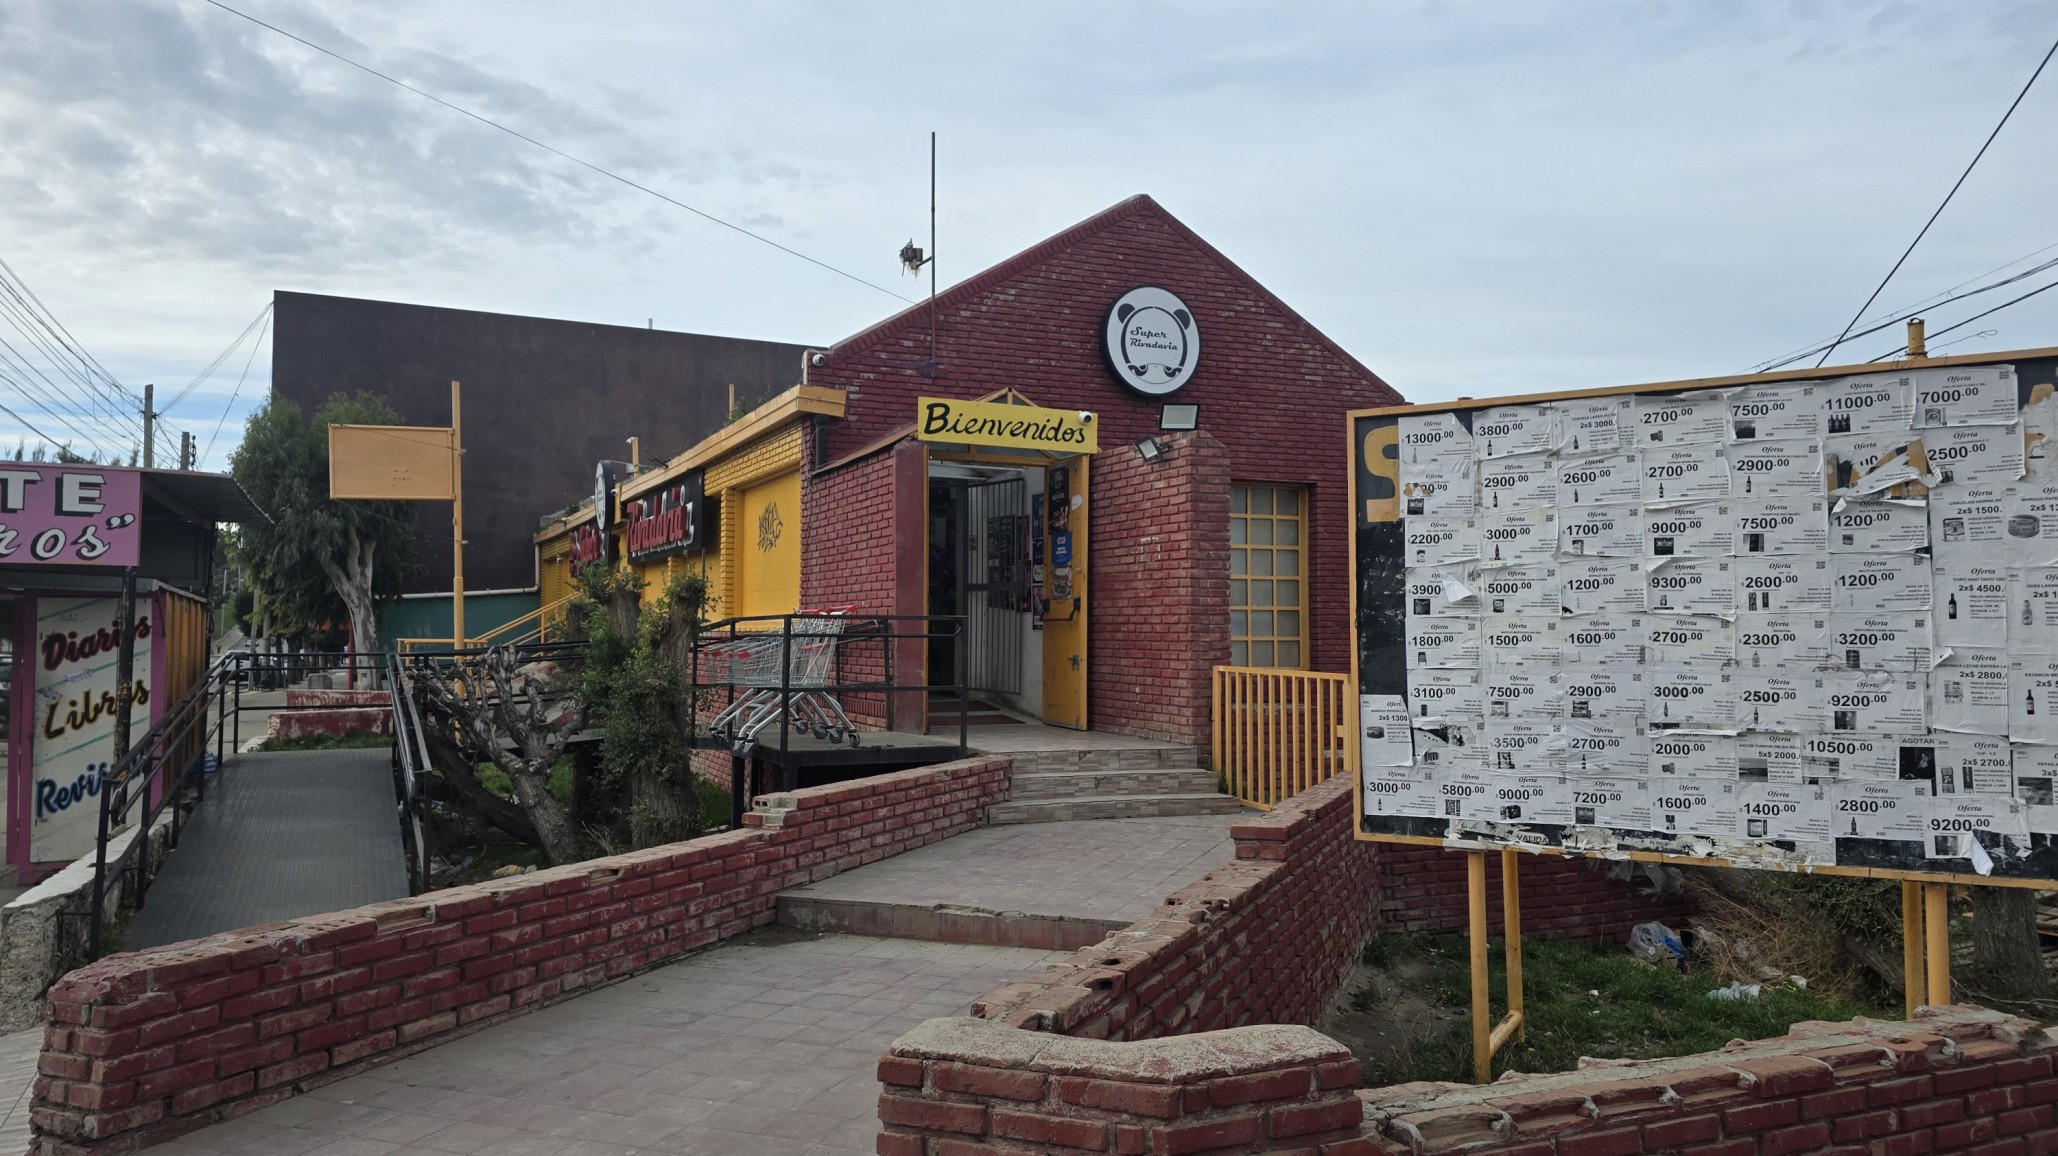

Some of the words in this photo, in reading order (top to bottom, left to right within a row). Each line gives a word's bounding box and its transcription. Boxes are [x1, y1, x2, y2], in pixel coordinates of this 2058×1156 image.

[1130, 326, 1167, 339] Super
[1947, 375, 1972, 383] Oferta
[1850, 382, 1873, 390] Oferta
[1499, 411, 1519, 420] Oferta
[924, 402, 1085, 443] Bienvenidos
[1423, 420, 1442, 428] Oferta
[1953, 431, 1978, 439] Oferta
[1853, 442, 1877, 450] Oferta
[1584, 458, 1605, 466] Oferta
[1504, 463, 1524, 471] Oferta
[1425, 472, 1444, 480] Oferta
[1859, 500, 1883, 508] Oferta
[2030, 504, 2046, 512] 2x$
[1957, 507, 1972, 515] 2x$
[1971, 567, 1996, 575] Oferta
[1676, 619, 1697, 627] Oferta
[1767, 620, 1790, 628] Oferta
[1864, 619, 1889, 627] Oferta
[41, 616, 152, 671] Diaris
[1971, 654, 1997, 662] Oferta
[1590, 673, 1611, 681] Oferta
[1676, 673, 1698, 681] Oferta
[1959, 671, 1975, 679] 2x$
[1767, 678, 1790, 686] Oferta
[2036, 680, 2052, 688] 2x$
[43, 678, 150, 740] Librs
[1513, 725, 1533, 733] Oferta
[1593, 726, 1614, 734] Oferta
[1769, 735, 1792, 743] Oferta
[1974, 741, 1999, 749] Oferta
[1461, 773, 1480, 781] Oferta
[2041, 769, 2058, 777] 3x$
[1595, 780, 1616, 788] Oferta
[1865, 786, 1889, 794] Oferta
[1767, 790, 1790, 799] Oferta
[1957, 804, 1982, 812] Oferta
